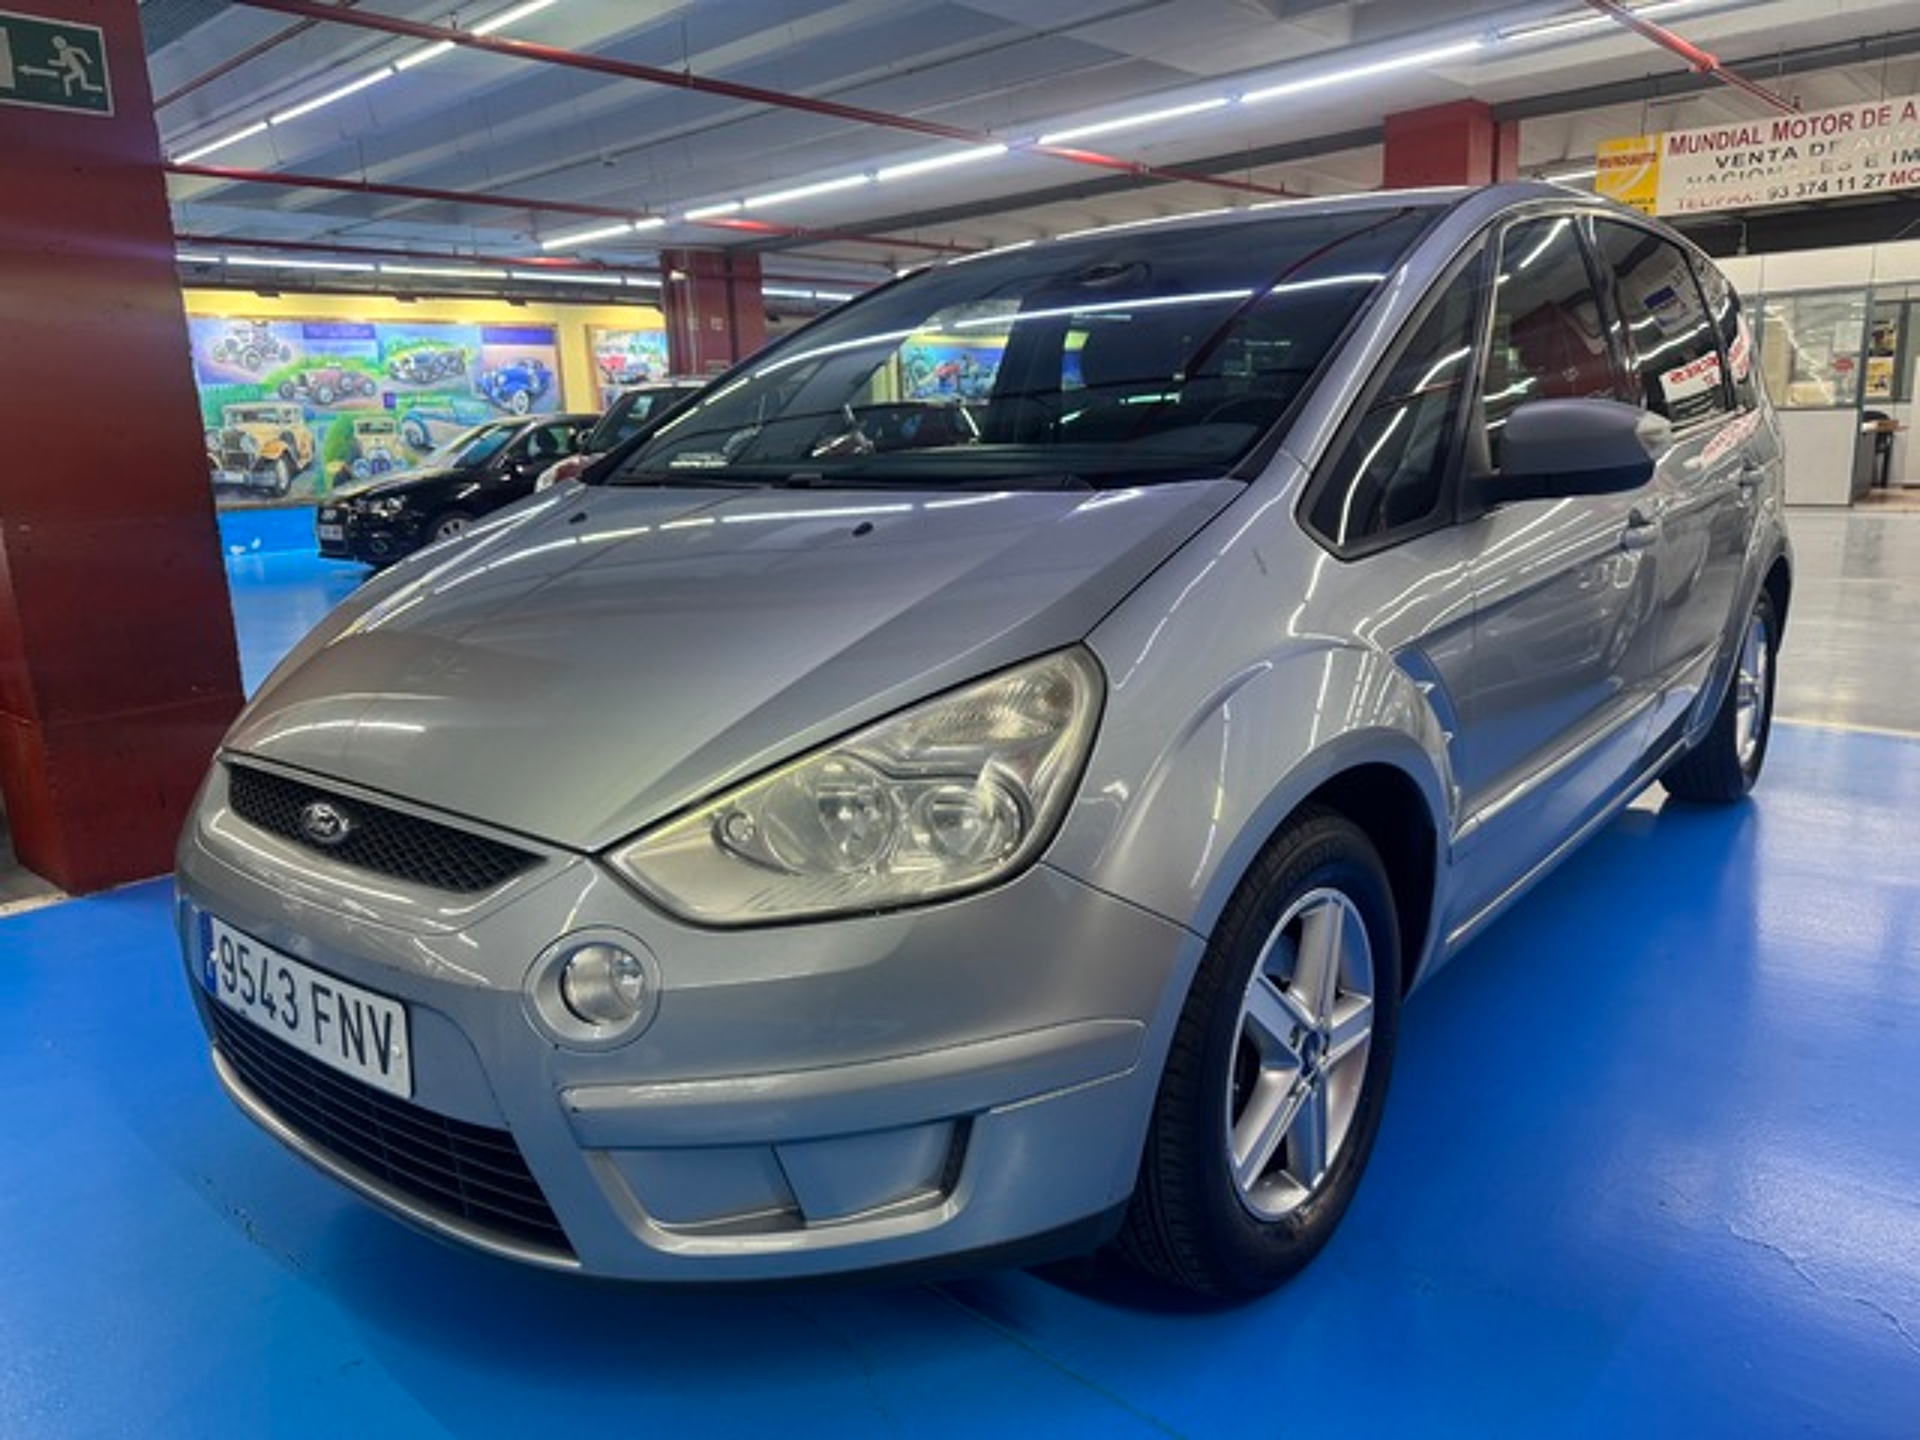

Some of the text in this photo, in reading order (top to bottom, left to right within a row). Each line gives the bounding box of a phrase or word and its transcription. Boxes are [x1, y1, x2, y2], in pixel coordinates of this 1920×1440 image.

[1667, 126, 1763, 156] MUNDIAL
[1771, 111, 1854, 141] MOTOR
[1860, 104, 1892, 130] DE
[1715, 146, 1798, 169] VENTA
[1795, 179, 1828, 198] 374
[1836, 176, 1855, 191] 11
[1862, 173, 1886, 189] 27
[218, 934, 392, 1076] 9543 FNV
